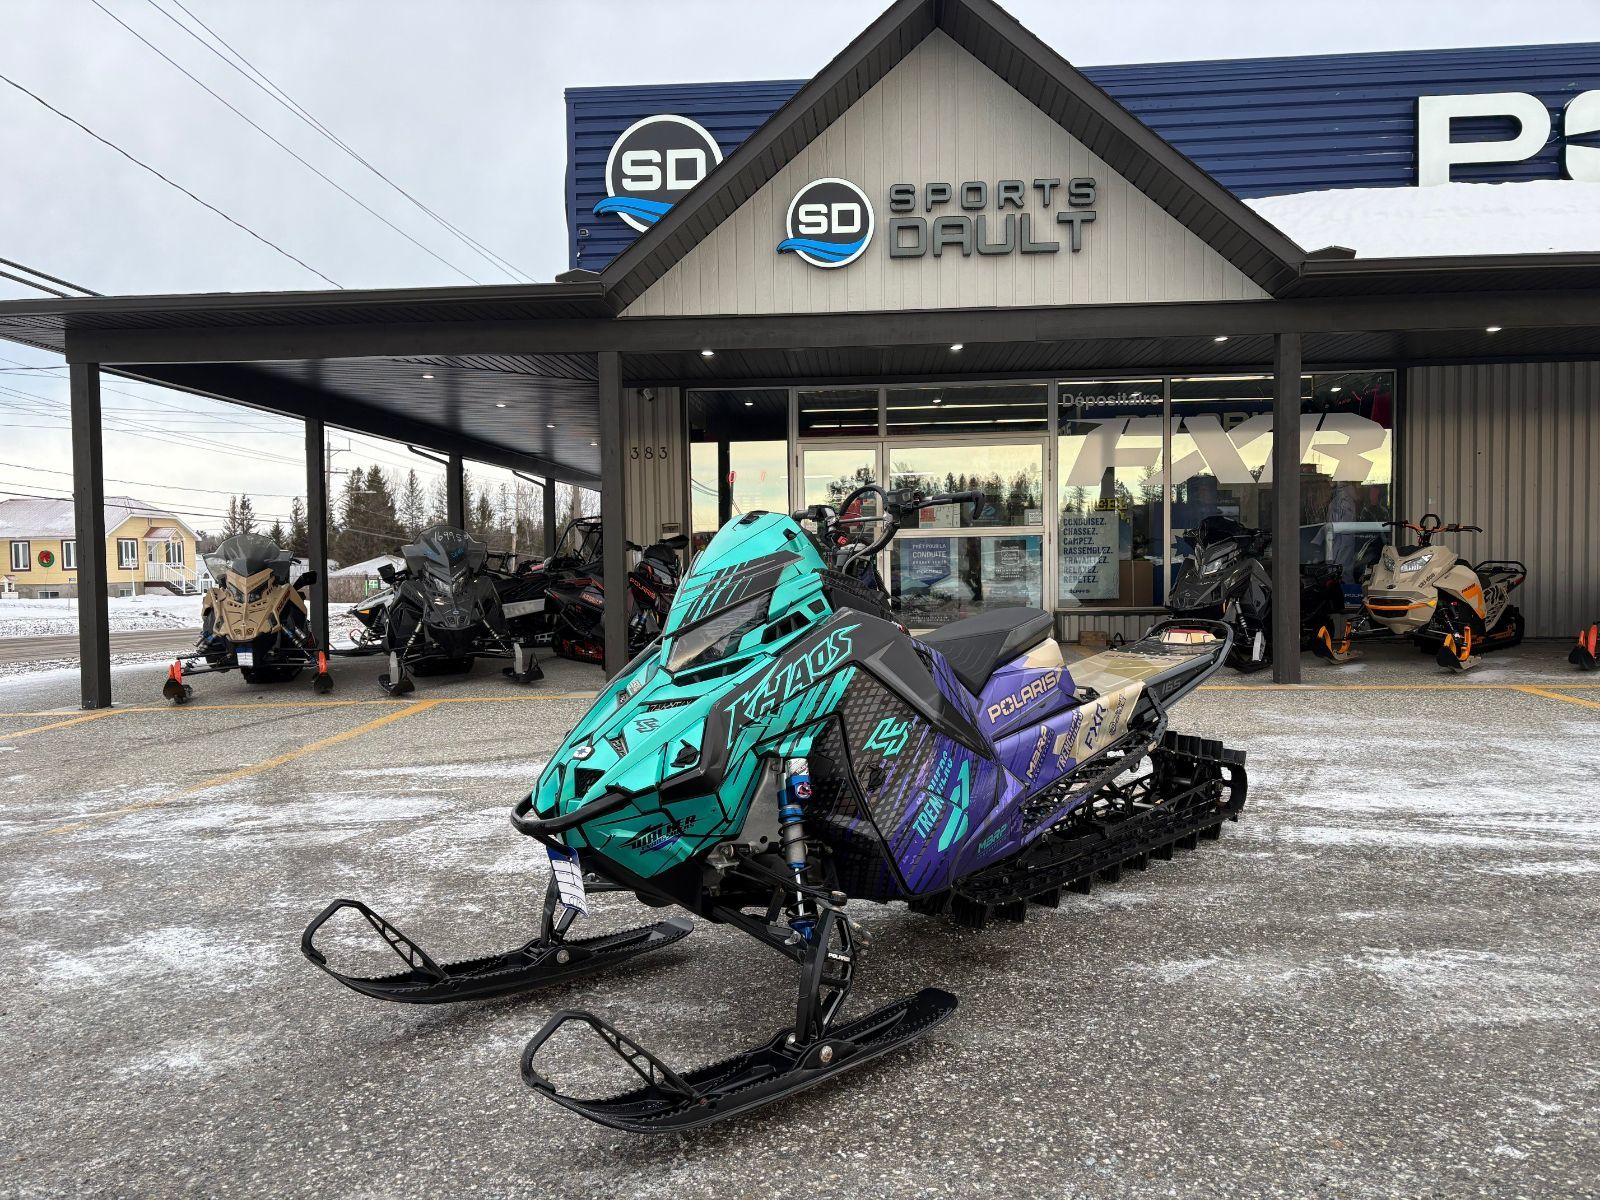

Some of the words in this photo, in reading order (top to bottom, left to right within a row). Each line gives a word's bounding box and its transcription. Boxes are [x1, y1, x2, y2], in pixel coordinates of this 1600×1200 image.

[1418, 90, 1600, 188] P
[621, 148, 707, 191] SD
[889, 177, 1097, 213] SPORTS
[798, 202, 861, 236] SD
[889, 211, 1097, 258] DAULT
[1061, 391, 1160, 411] Dépositaire
[630, 446, 668, 460] 383
[1065, 412, 1388, 487] FXR
[1063, 527, 1098, 536] CHASSEZ.
[1063, 537, 1095, 546] CAMPEZ.
[1063, 546, 1113, 555] RASSEMBLEZ.
[724, 623, 863, 750] KHAOS
[986, 670, 1058, 724] POLARIS
[1084, 702, 1106, 750] FXR
[1026, 725, 1048, 780] MBRP
